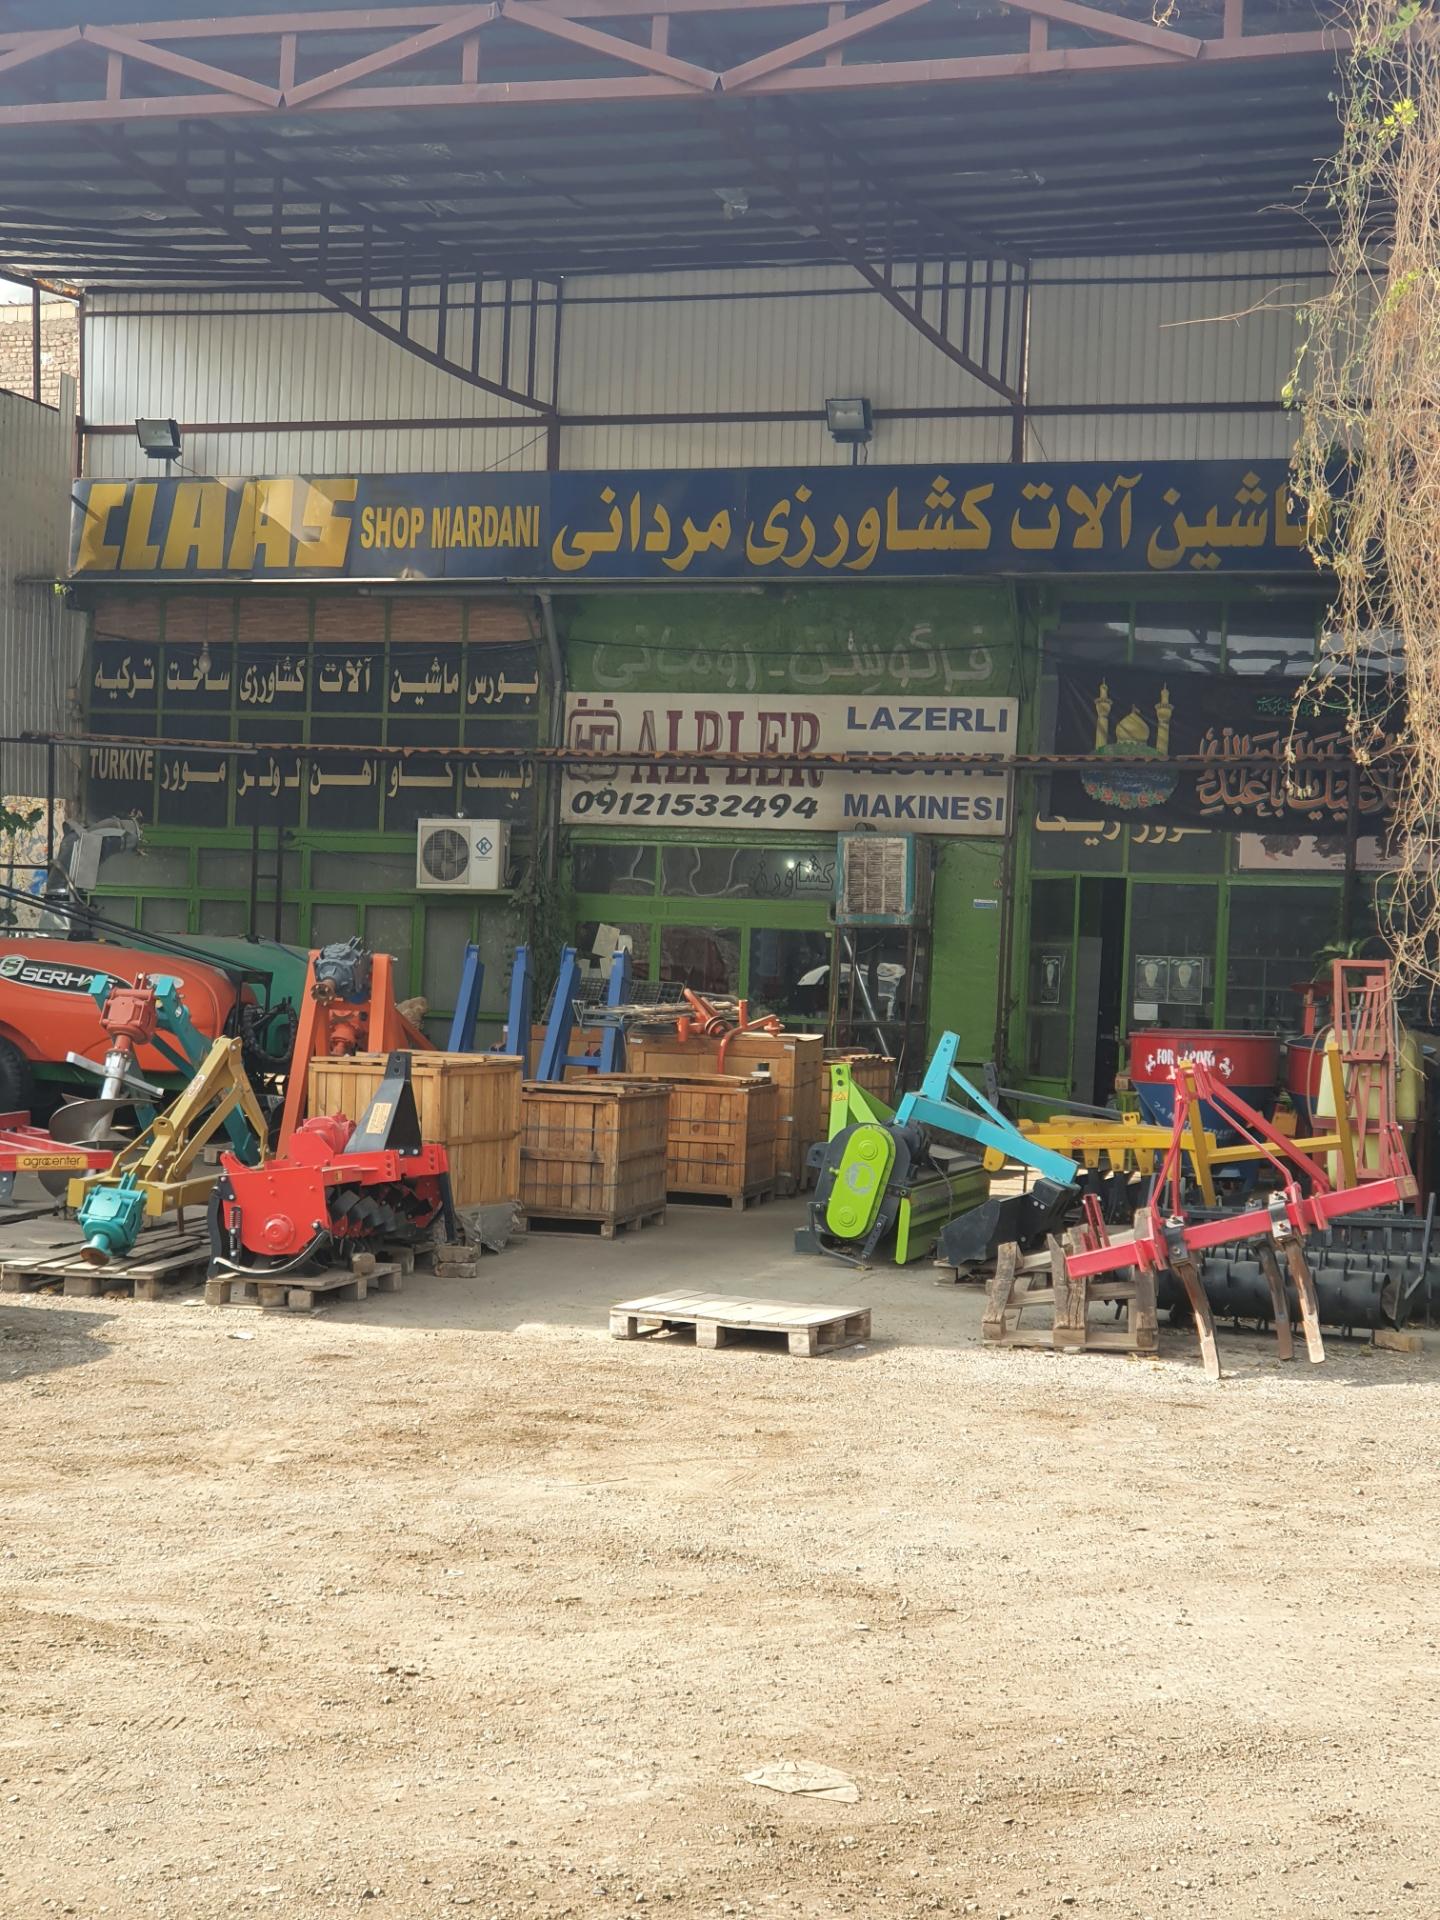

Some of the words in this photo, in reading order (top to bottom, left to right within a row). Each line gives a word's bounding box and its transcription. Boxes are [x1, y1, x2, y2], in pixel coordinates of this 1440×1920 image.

[76, 478, 358, 571] CLAAS
[360, 505, 424, 549] SHOP
[431, 505, 540, 549] MARDANI
[551, 486, 732, 571] مردانی
[746, 475, 994, 570] کشاورزی
[1011, 472, 1144, 550] آلات
[95, 656, 155, 699] ترکیه
[166, 658, 231, 691] ساخت
[239, 656, 306, 703] کشاورزی
[319, 657, 372, 692] آلات
[391, 656, 459, 703] ماشین
[467, 669, 539, 704] بورس
[847, 706, 1008, 733] LAZERLI
[631, 710, 824, 788] ALPLER
[571, 788, 819, 819] 09121532494
[843, 793, 1005, 821] MAKINESI
